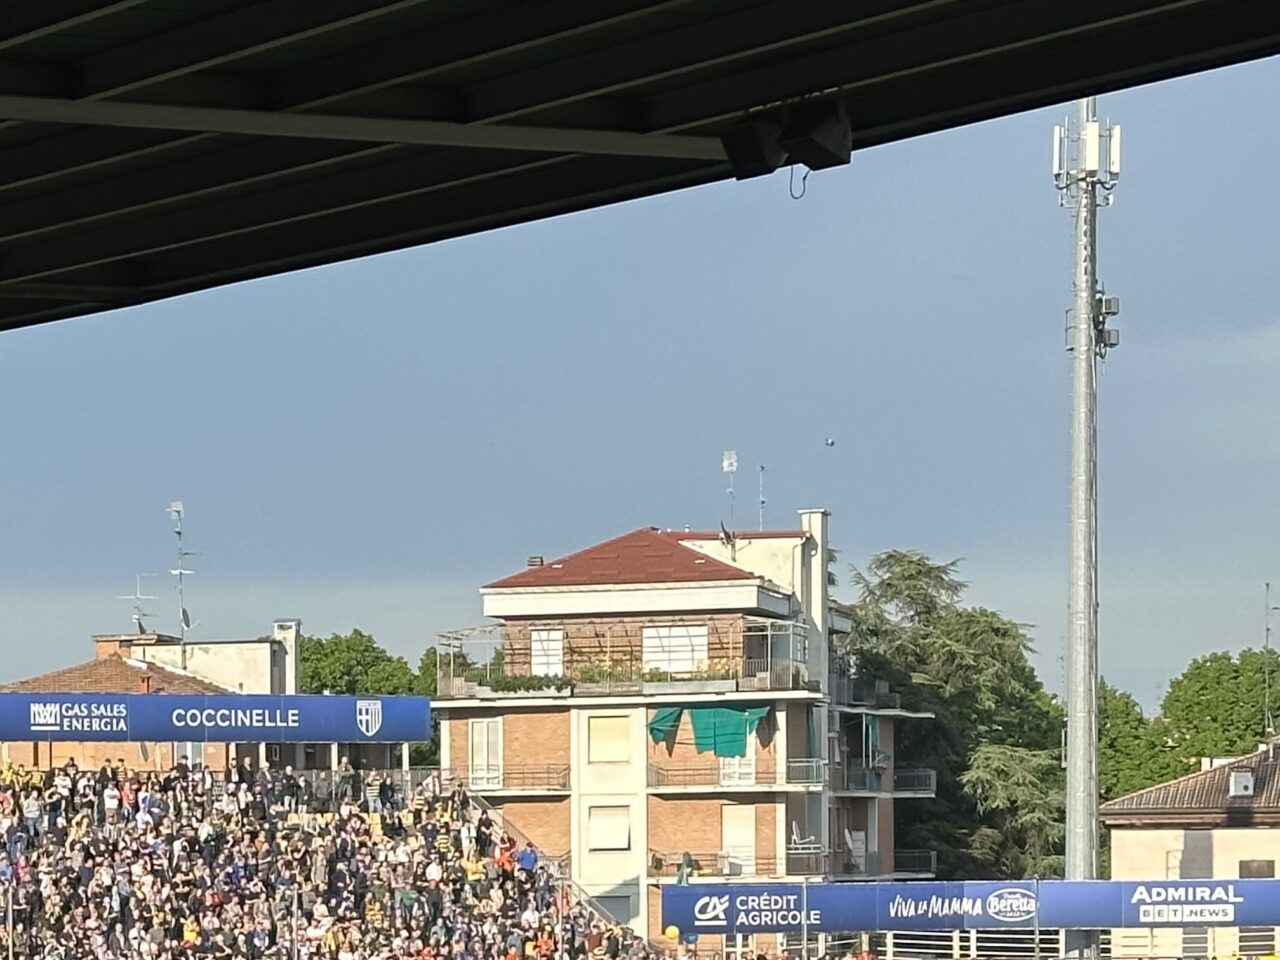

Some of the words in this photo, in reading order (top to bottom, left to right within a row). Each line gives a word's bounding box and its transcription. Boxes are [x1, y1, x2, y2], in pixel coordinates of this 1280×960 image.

[61, 703, 88, 717] GAS
[91, 703, 127, 717] SALES
[172, 708, 300, 728] COCCINELLE
[63, 718, 127, 731] ENERGIA
[736, 892, 798, 910] CRÉDIT
[1131, 885, 1244, 903] ADMIRAL
[928, 895, 982, 918] MAMMA
[736, 911, 821, 925] AGRICOLE
